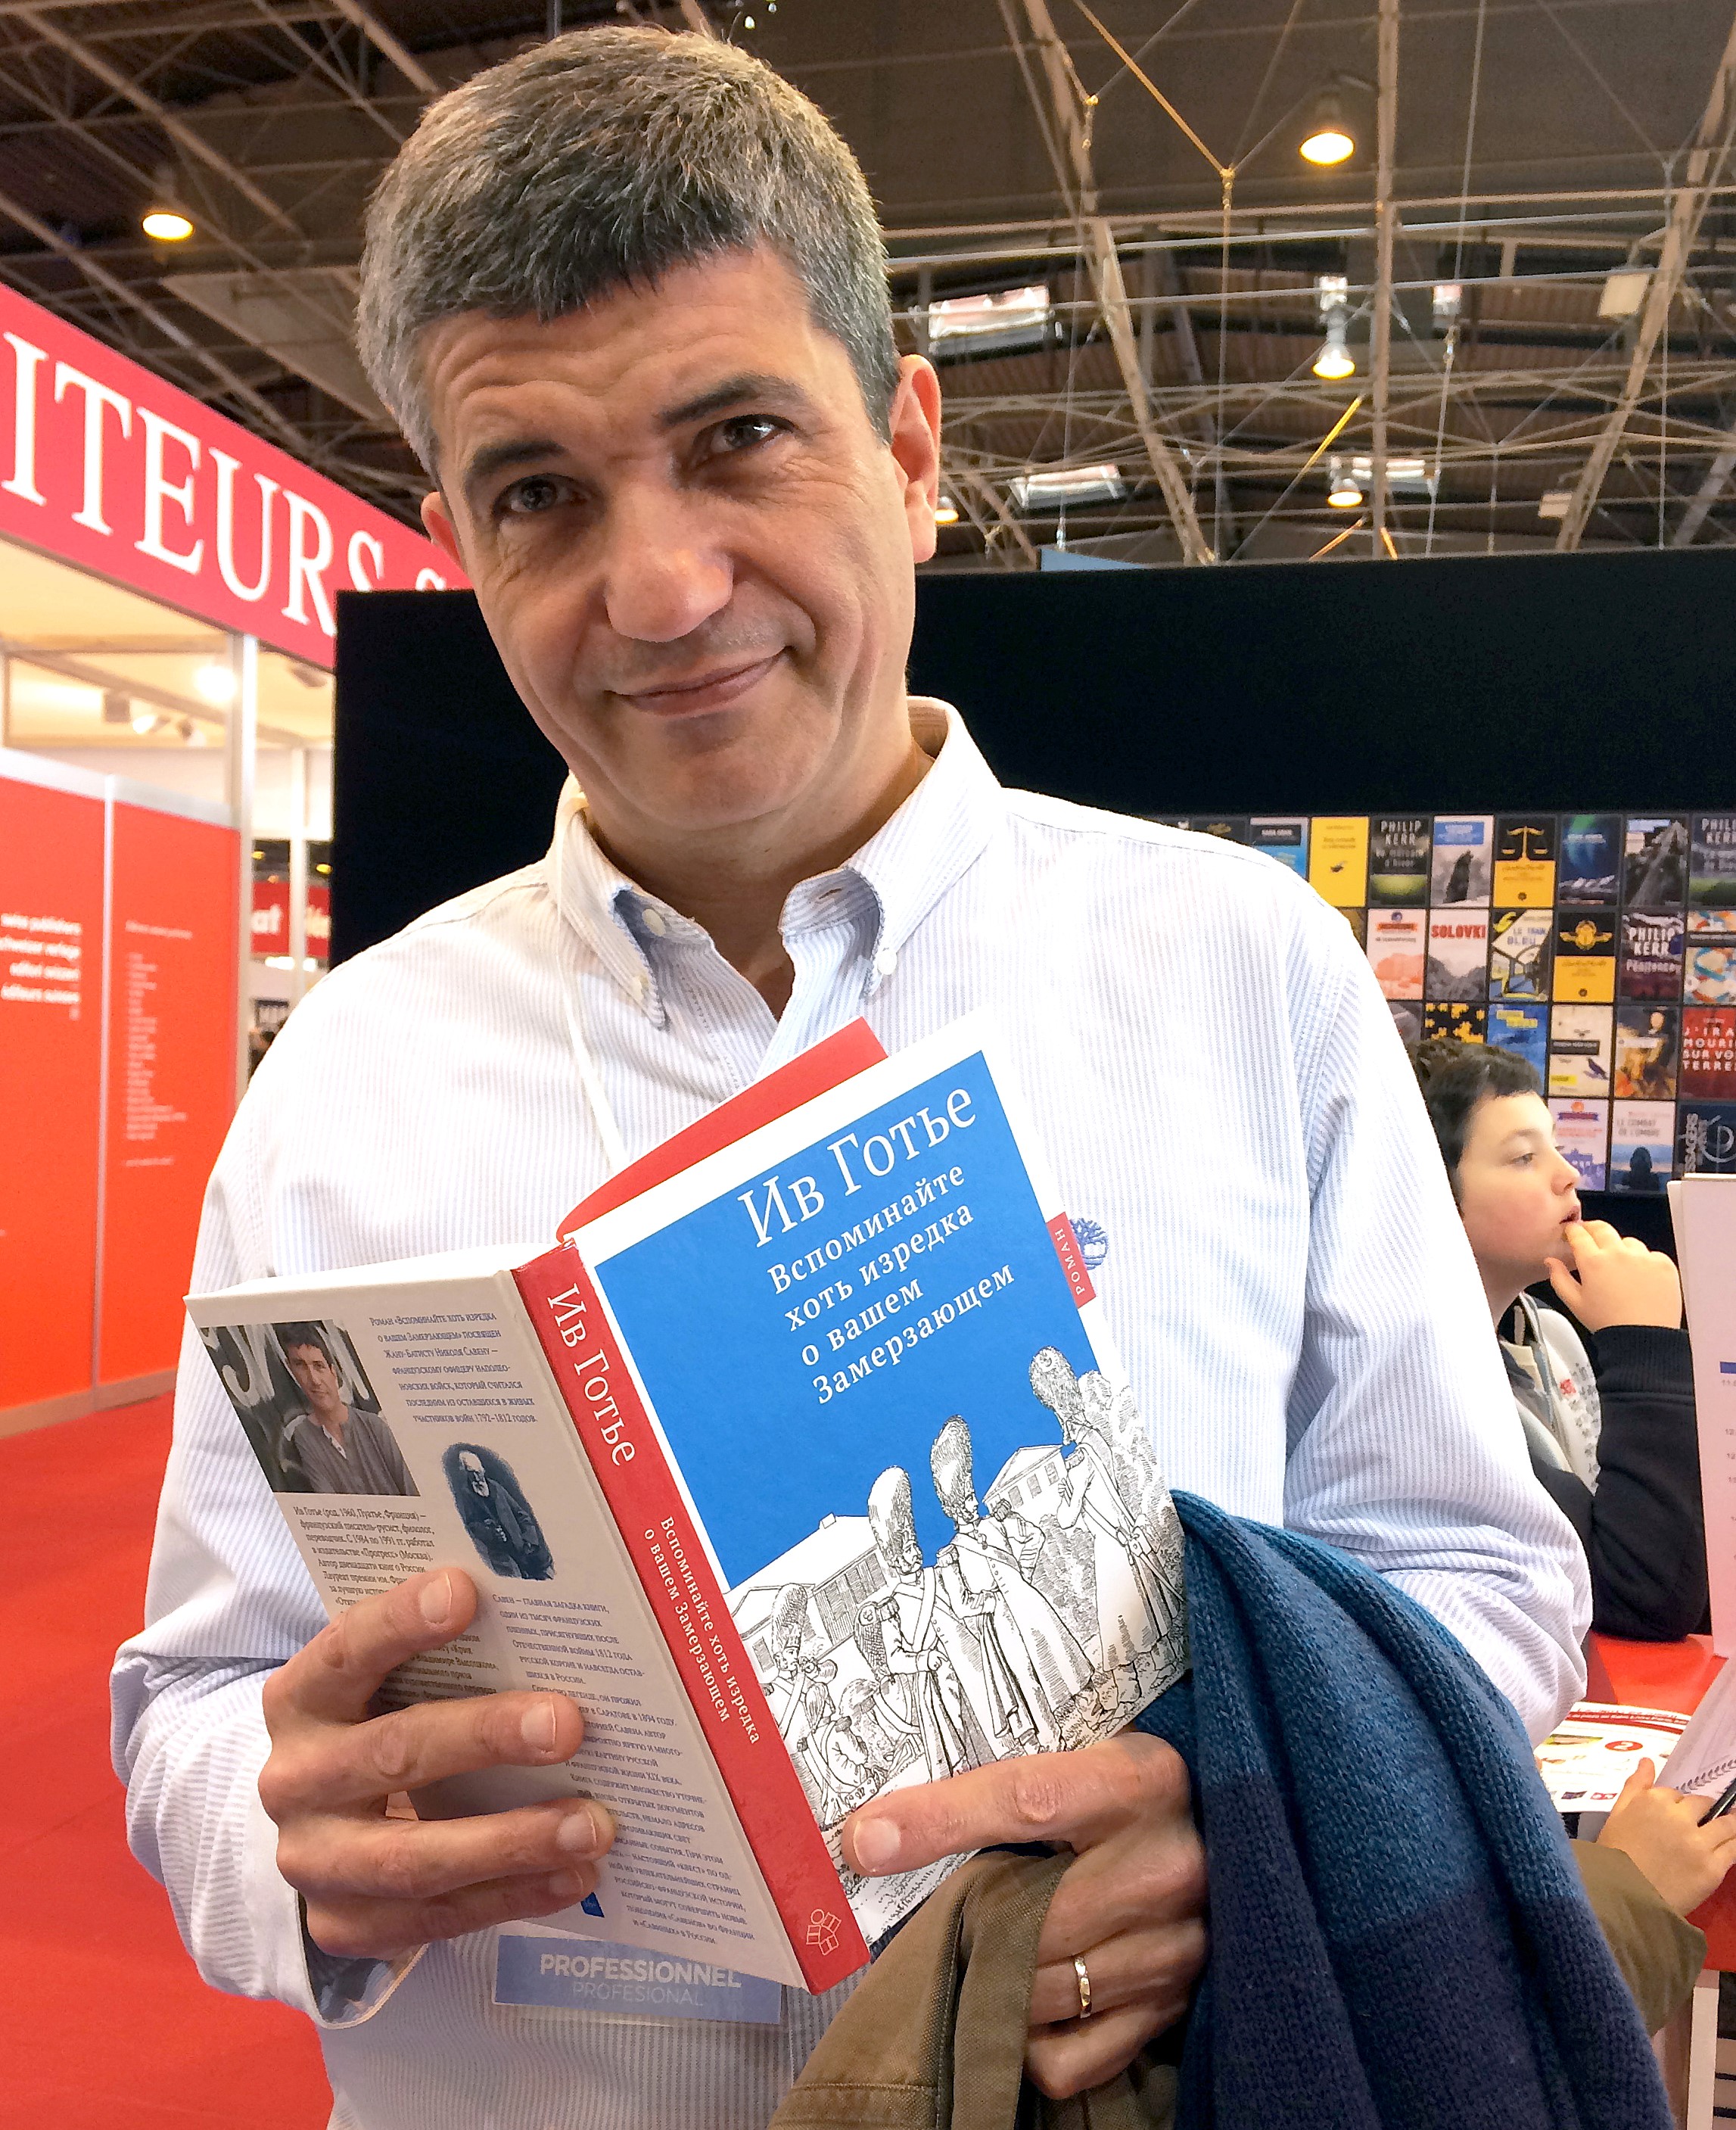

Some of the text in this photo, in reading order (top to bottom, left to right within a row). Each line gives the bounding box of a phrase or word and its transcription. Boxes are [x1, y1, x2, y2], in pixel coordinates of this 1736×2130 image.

[1381, 821, 1421, 832] PHILIP
[1385, 833, 1415, 845] KERR
[1431, 924, 1486, 939] SOLOVKI
[1629, 927, 1675, 941] PHILIP
[1634, 942, 1669, 955] KERR
[1683, 1038, 1736, 1048] MOURI
[1715, 1050, 1736, 1060] VO
[1682, 1060, 1736, 1071] TERRE
[738, 1088, 976, 1247] Ив Готье
[767, 1164, 965, 1294] Вспоминайте
[785, 1204, 974, 1331] хоть изредка
[1055, 1228, 1085, 1295] РОМАН
[801, 1278, 925, 1366] о вашем
[813, 1264, 1015, 1404] Замерзающем
[547, 1283, 636, 1465] Ив Готье
[645, 1528, 730, 1722] о вашем Замерзающем
[661, 1515, 760, 1744] Вспоминайте хоть изредка
[540, 1954, 742, 1988] PROFESSIONNEL
[572, 1981, 704, 2006] PROFESIONAL
